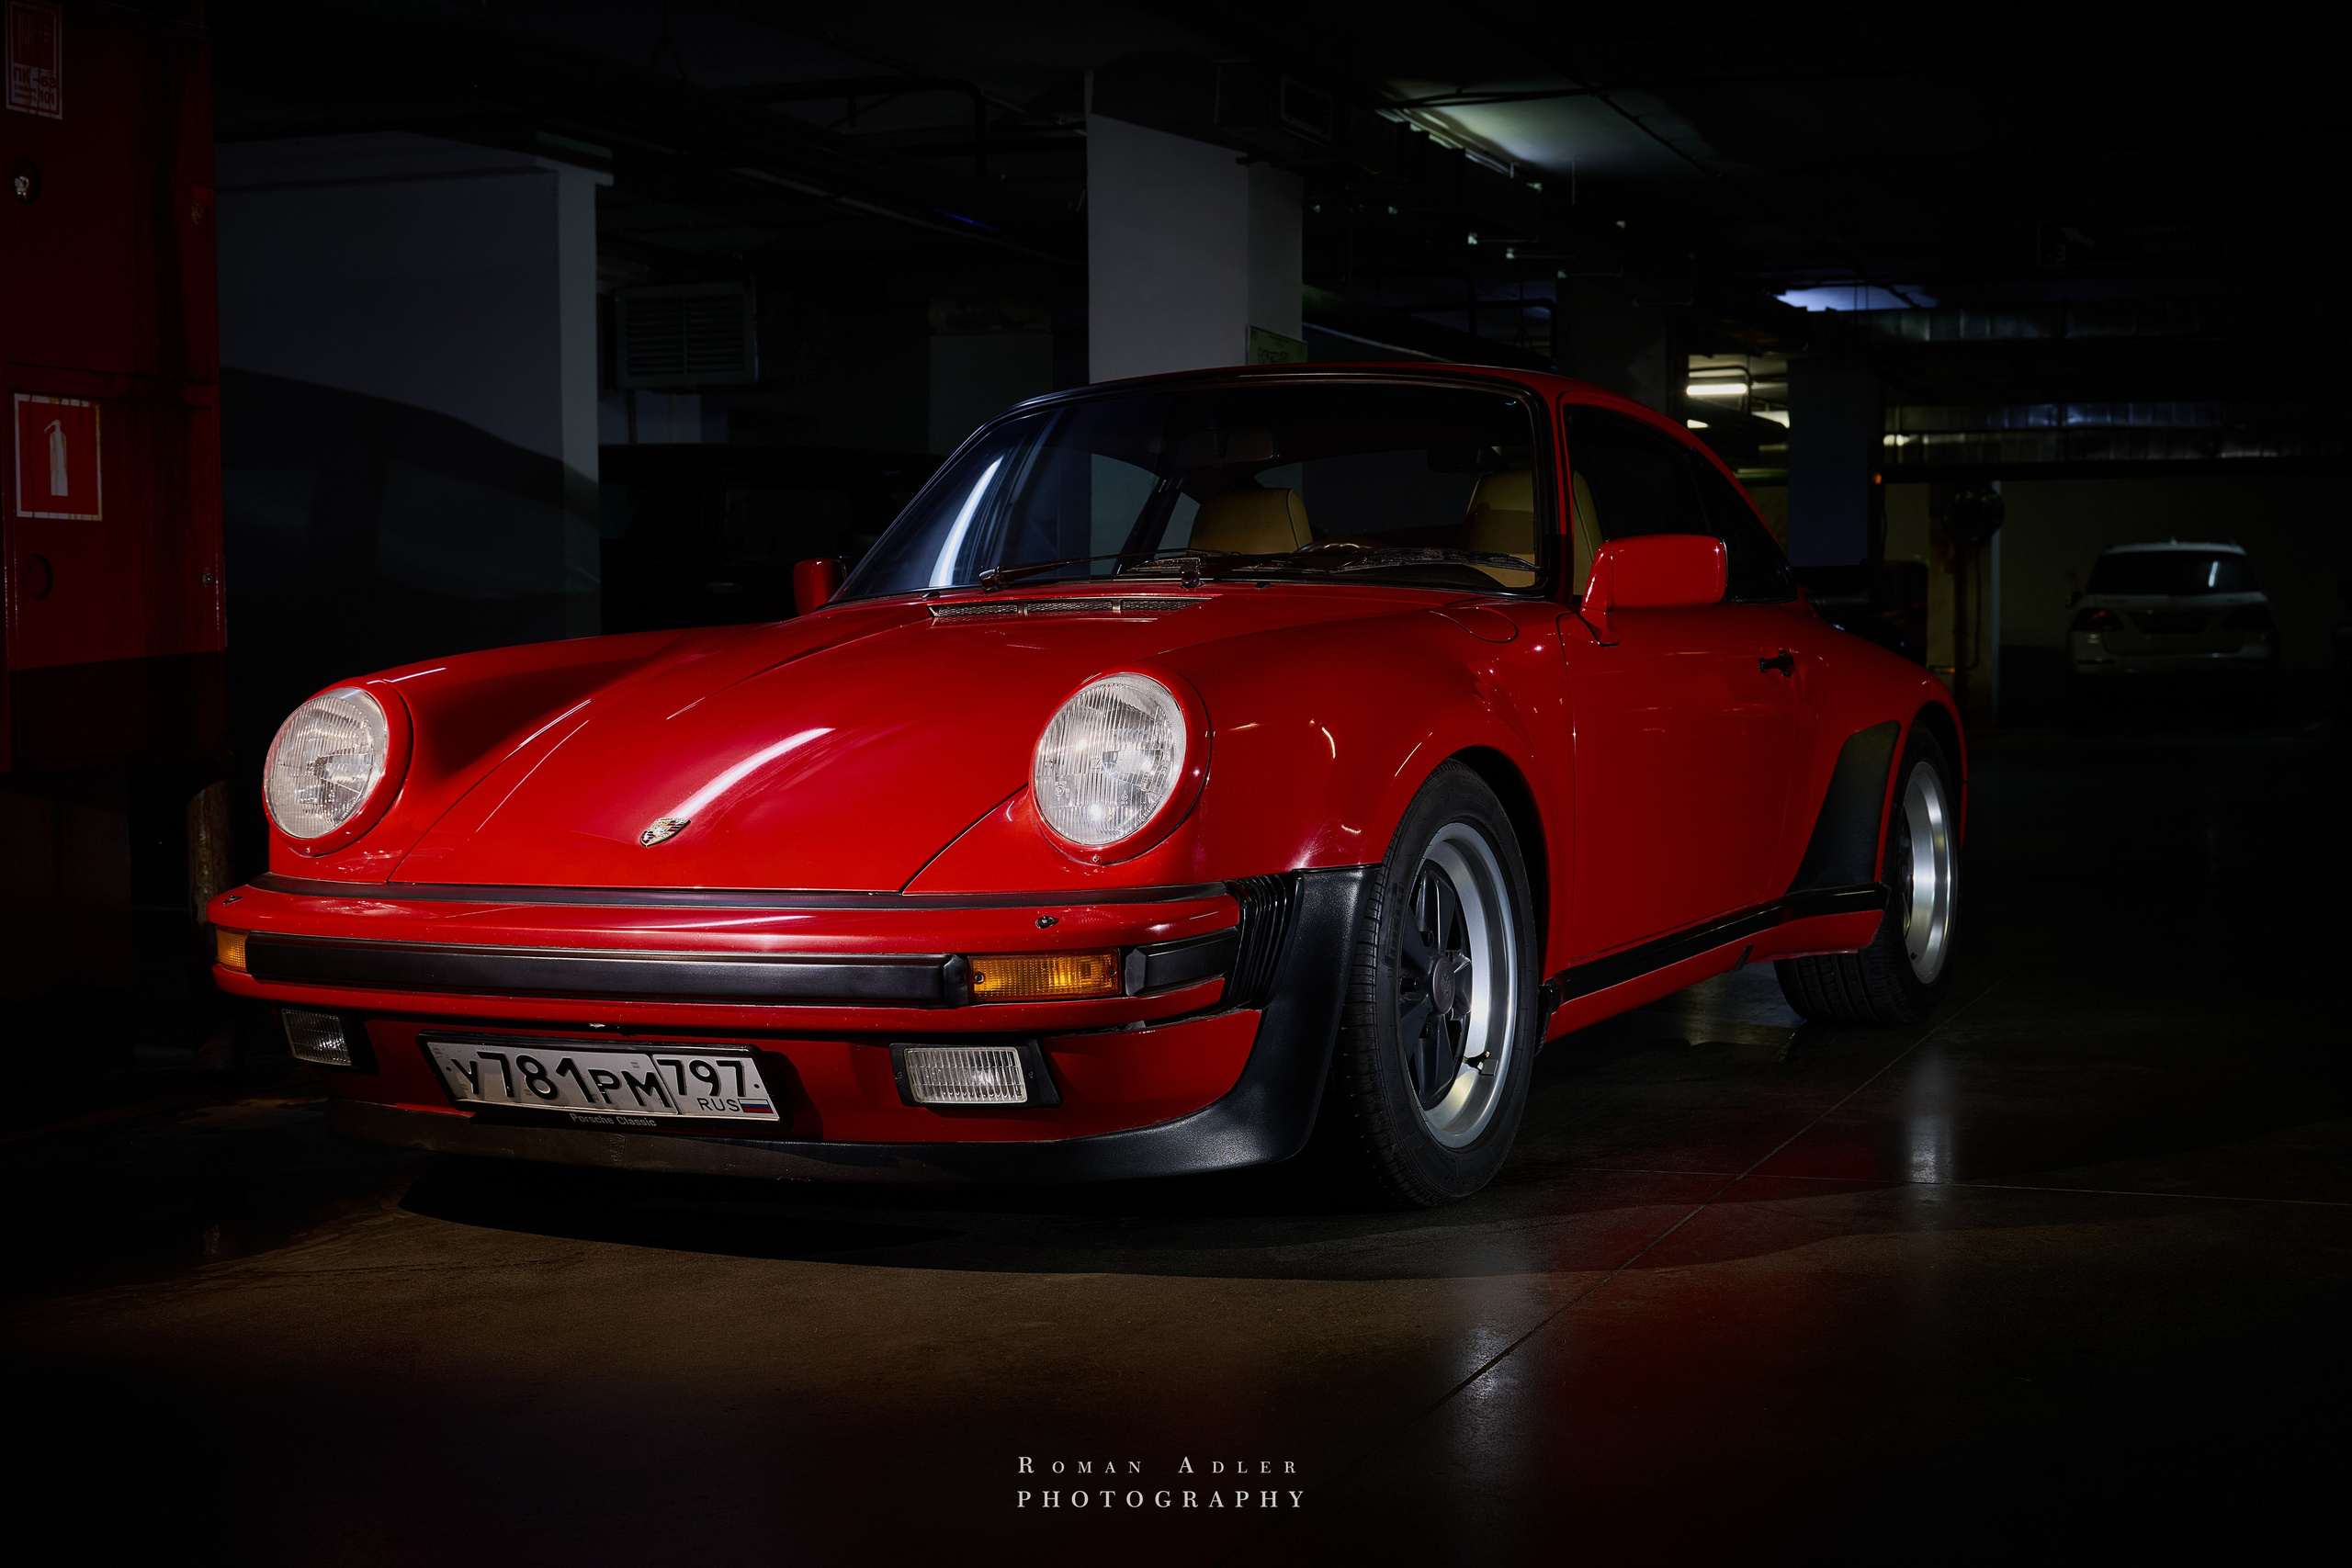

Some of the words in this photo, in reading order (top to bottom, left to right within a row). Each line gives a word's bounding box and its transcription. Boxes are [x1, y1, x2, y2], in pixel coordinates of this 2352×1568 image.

[40, 90, 54, 105] 101
[657, 1059, 747, 1098] 797
[696, 1097, 740, 1112] RUS
[570, 1113, 615, 1126] Porsche
[617, 1116, 658, 1128] Classic
